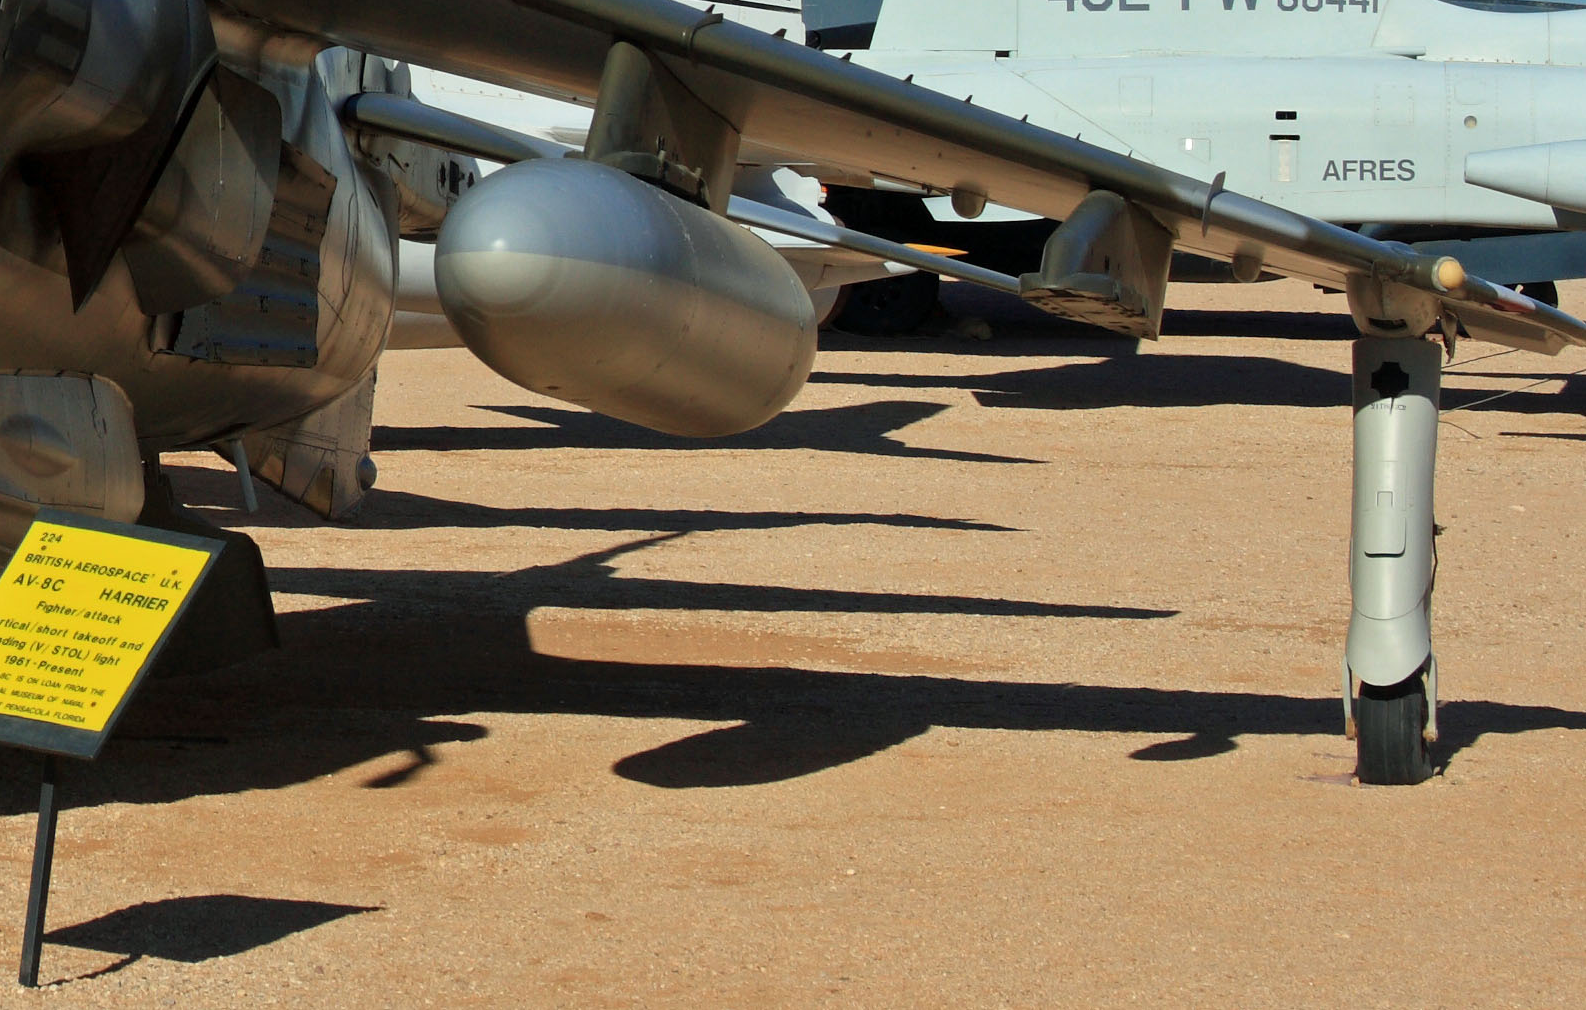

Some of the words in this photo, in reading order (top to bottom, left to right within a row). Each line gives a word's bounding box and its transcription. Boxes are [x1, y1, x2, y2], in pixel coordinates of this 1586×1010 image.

[1322, 158, 1415, 183] AFRES
[39, 532, 63, 543] 224
[24, 553, 73, 570] BRITISH
[12, 573, 66, 592] AV-8C
[99, 587, 169, 612] HARRIER
[72, 630, 118, 646] takeoff
[119, 641, 145, 651] and
[93, 652, 121, 666] light
[10, 689, 45, 701] MUSEUM
[41, 679, 62, 689] LOAN
[64, 683, 88, 693] FROM
[90, 688, 107, 697] THE
[5, 703, 51, 716] PENSACOLA
